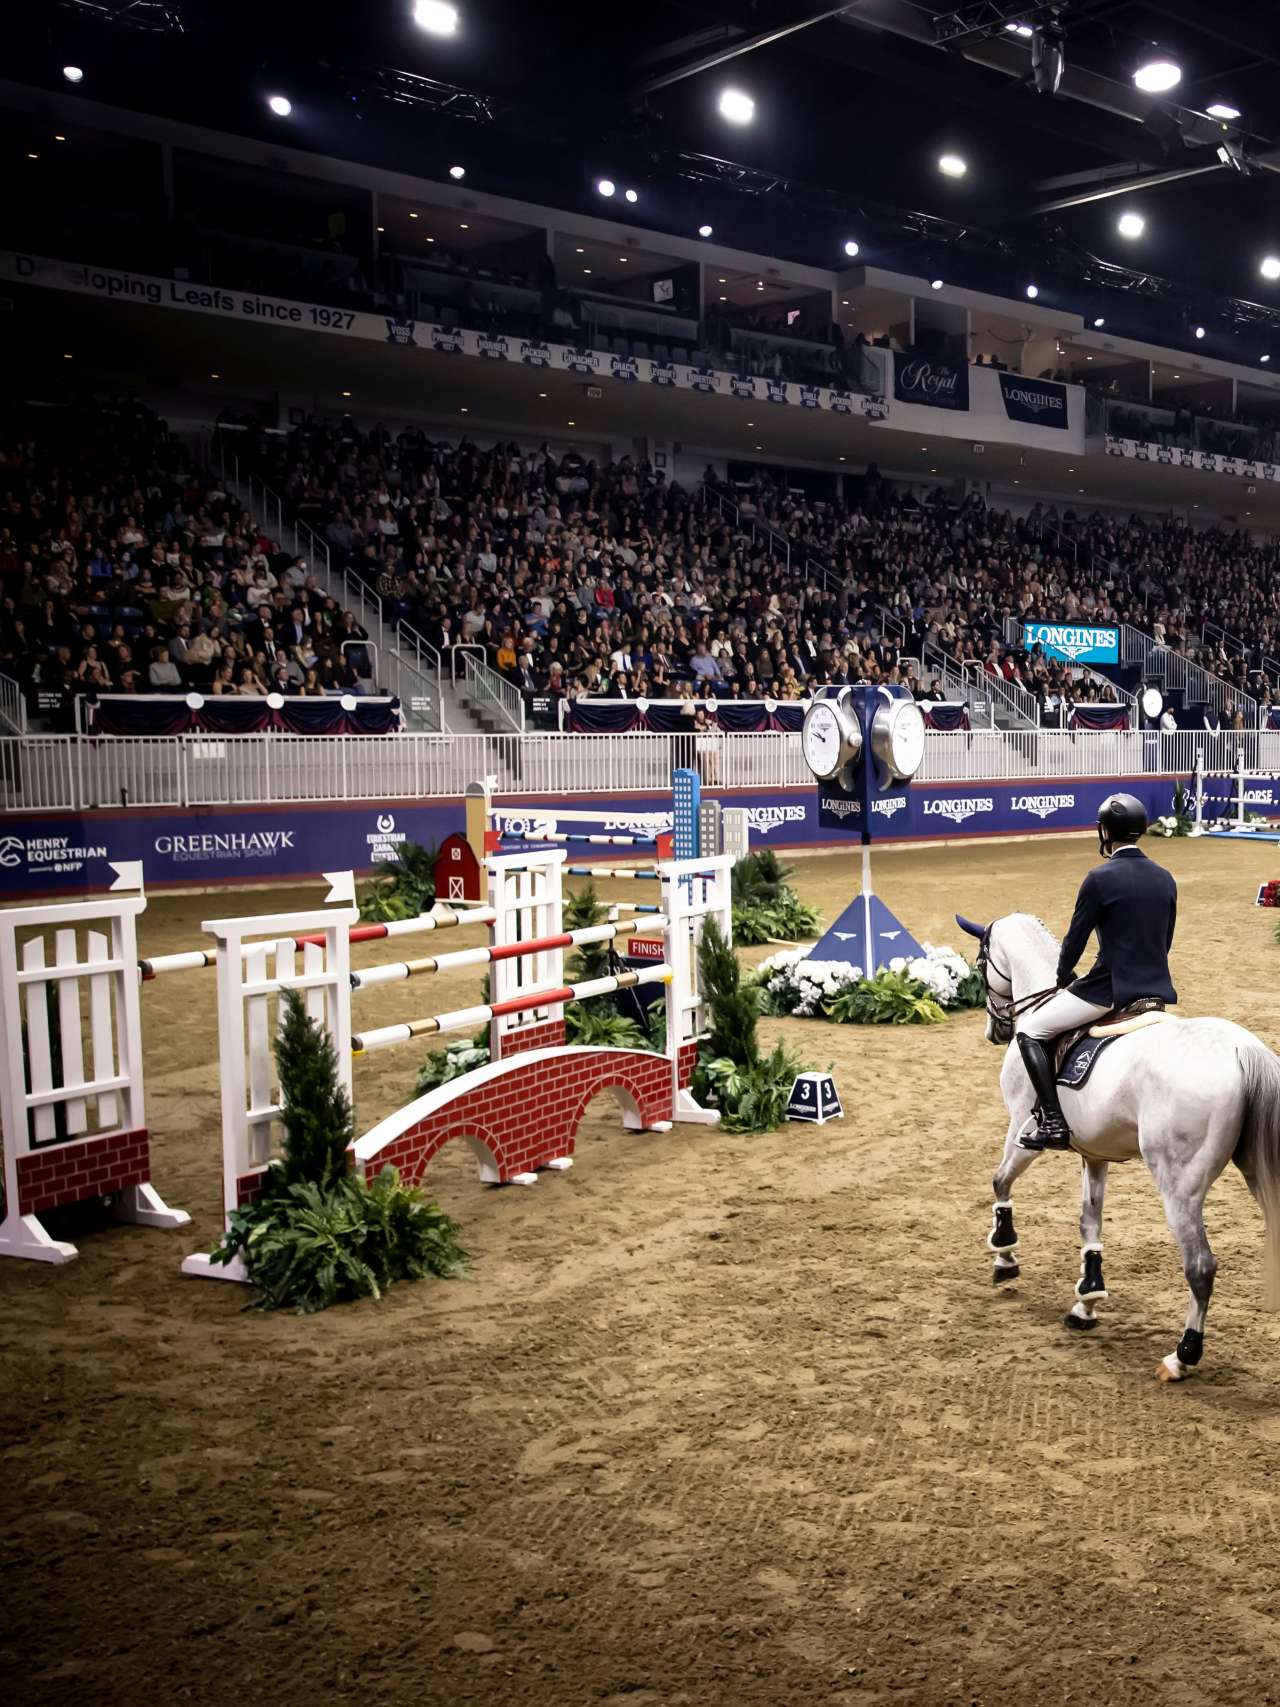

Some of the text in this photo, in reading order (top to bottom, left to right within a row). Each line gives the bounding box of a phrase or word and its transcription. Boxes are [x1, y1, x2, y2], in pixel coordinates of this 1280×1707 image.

[169, 281, 235, 312] Leafs
[243, 293, 303, 323] since
[309, 308, 356, 331] 1927
[901, 361, 958, 394] Royal
[1004, 387, 1064, 410] LONGINES
[1026, 626, 1117, 648] LONGINES
[822, 798, 861, 812] LONGINES
[871, 797, 906, 812] LONGINES
[924, 798, 995, 814] LONGINES
[1011, 795, 1076, 810] LONGINES
[746, 806, 806, 822] NGINES
[26, 837, 69, 850] HENRY
[155, 831, 294, 854] GREENHAWK
[27, 847, 107, 863] EQUESTRIAN
[173, 848, 278, 862] EQUESTRIAN SPORT
[632, 942, 665, 956] FINISH
[800, 1082, 811, 1100] 3
[824, 1081, 832, 1099] 3
